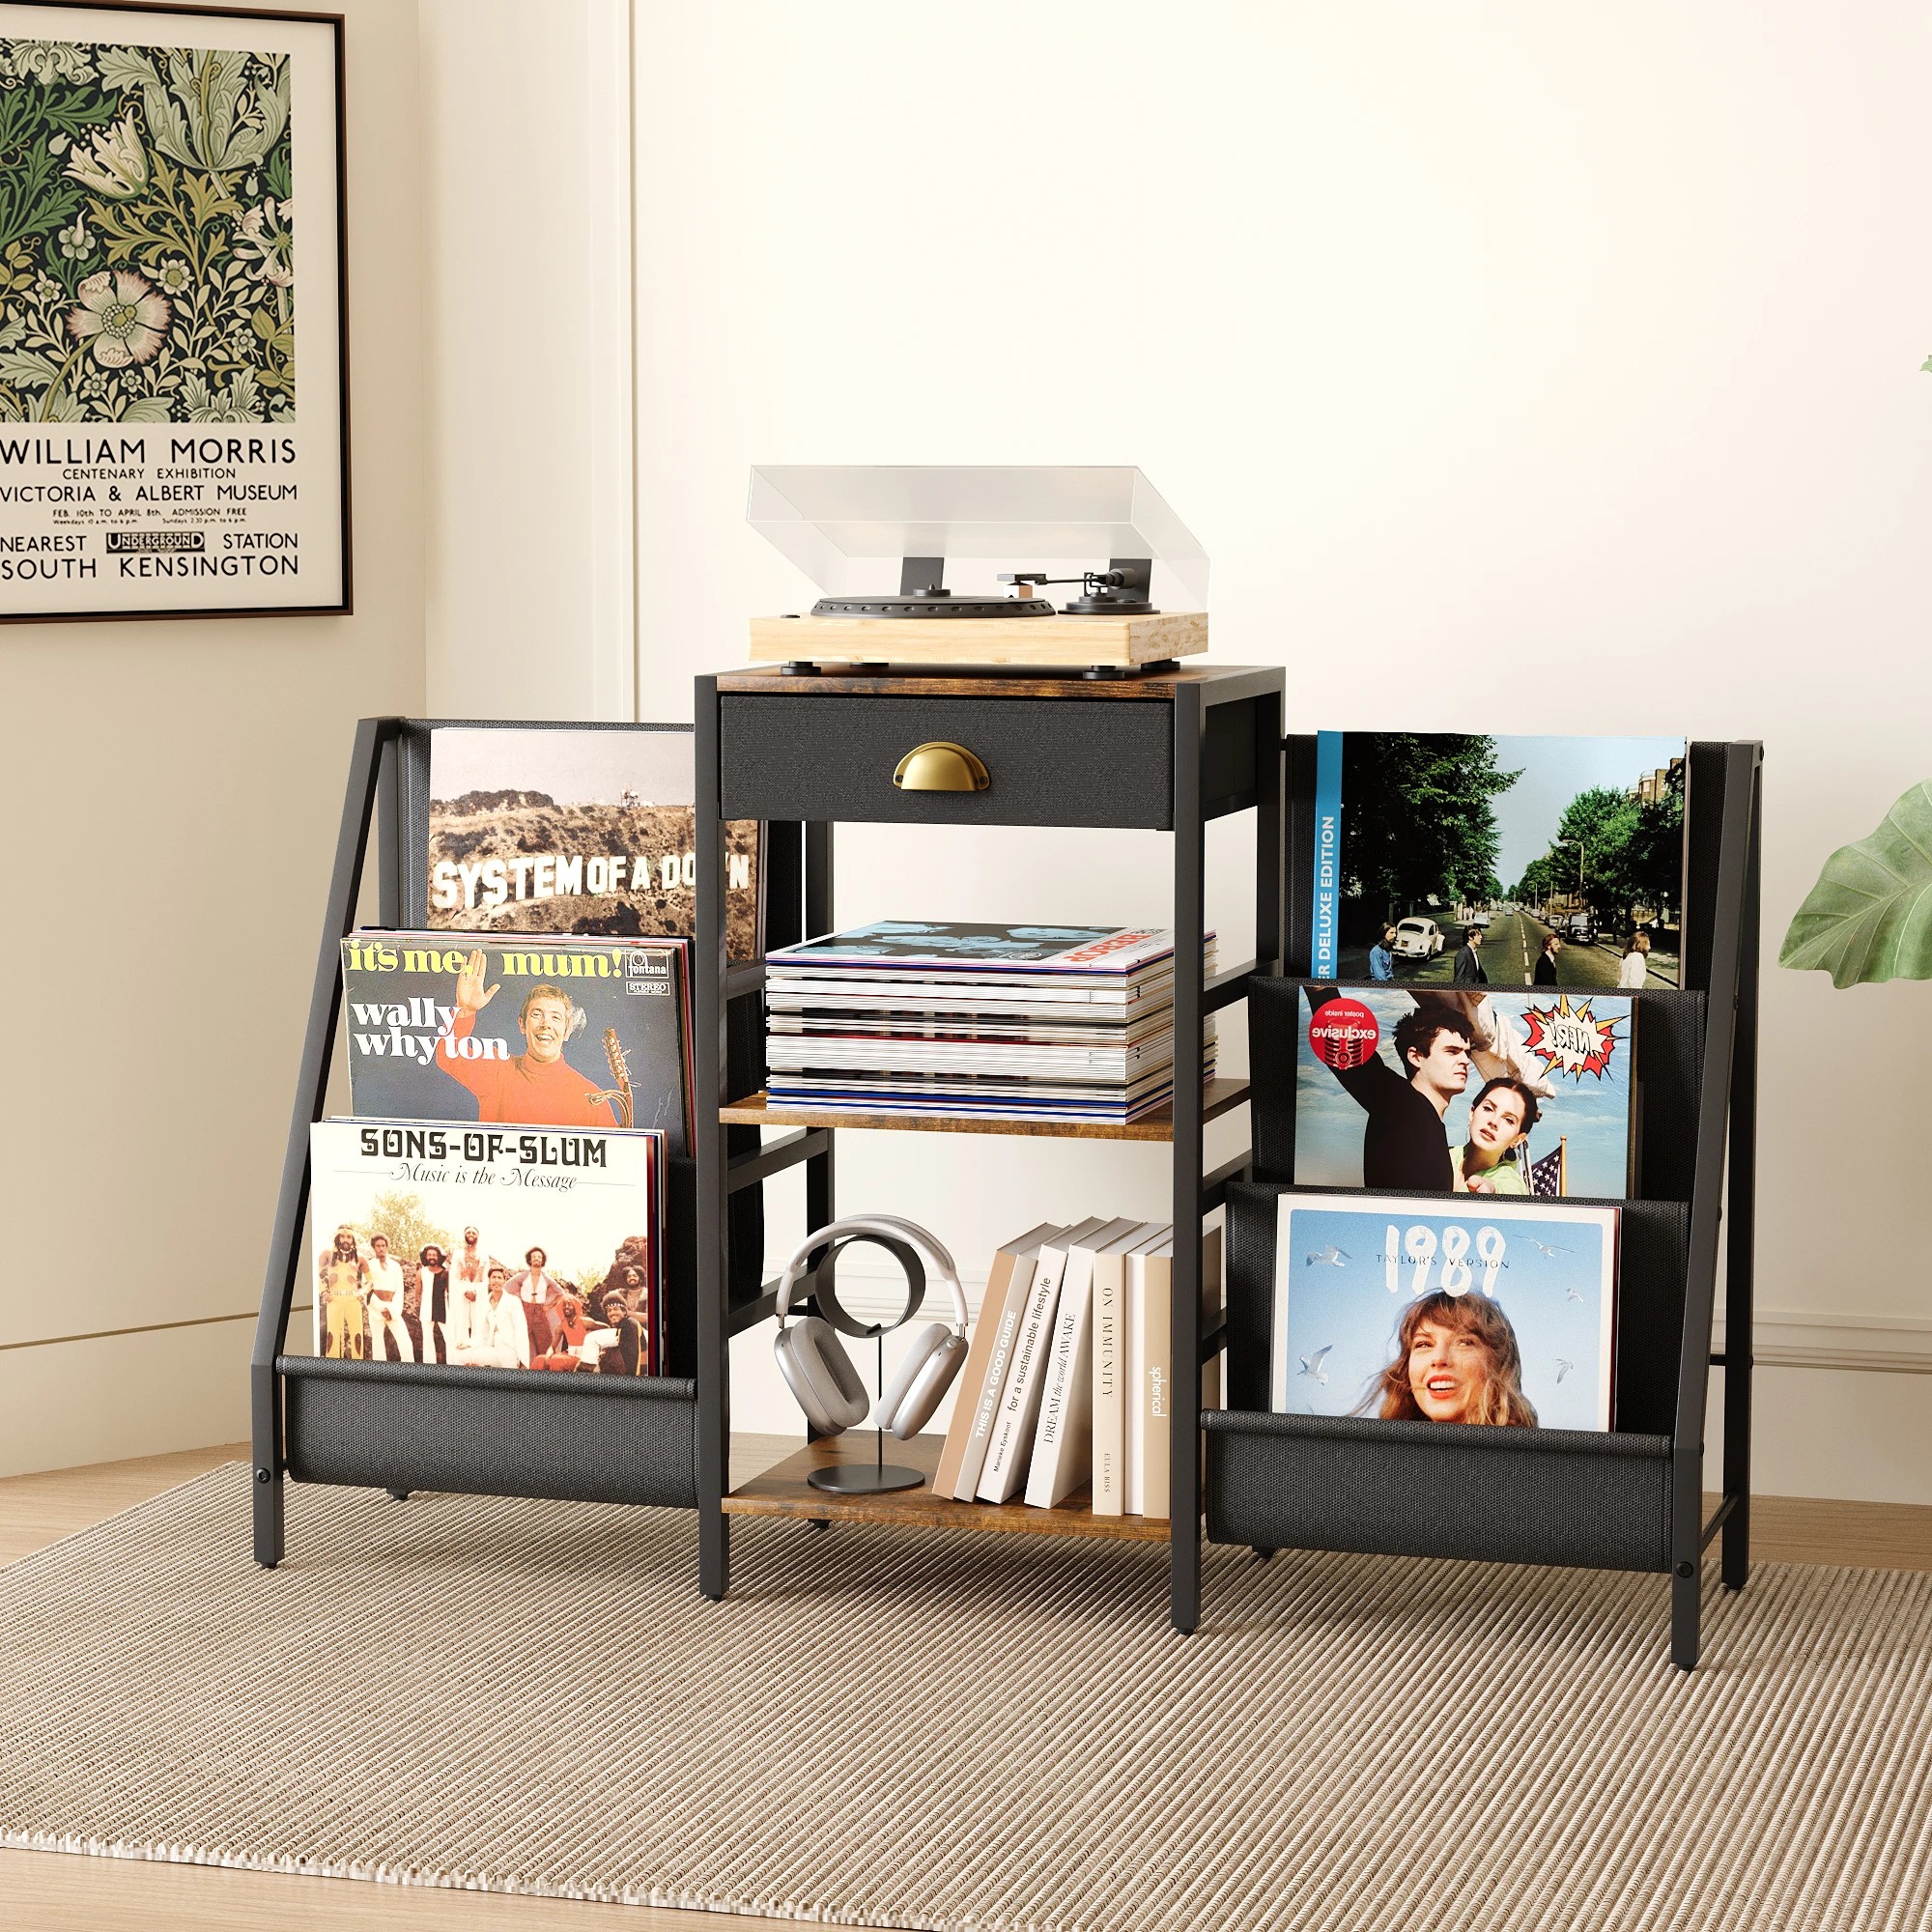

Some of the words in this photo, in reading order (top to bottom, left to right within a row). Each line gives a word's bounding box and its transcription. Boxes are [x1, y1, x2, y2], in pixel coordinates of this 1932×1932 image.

[0, 439, 146, 464] WILLIAM
[171, 439, 296, 464] MORRIS
[63, 469, 145, 479] CENTENARY
[156, 468, 236, 479] EXHIBITION
[0, 486, 96, 502] VICTORIA
[108, 485, 122, 501] &
[135, 485, 205, 501] ALBERT
[217, 484, 298, 500] MUSEUM
[99, 508, 112, 517] TO
[118, 508, 142, 517] APRIL
[172, 507, 220, 516] ADMISSION
[226, 507, 247, 516] FREE
[0, 536, 87, 553] NEAREST
[107, 532, 205, 550] UNDERGROUND
[223, 533, 298, 550] STATION
[2, 558, 96, 580] SOUTH
[120, 554, 298, 578] KENSINGTON
[1320, 816, 1335, 888] EDITION
[432, 855, 582, 909] SYSTEM
[587, 855, 627, 895] OF
[632, 855, 651, 890] A
[662, 851, 750, 890] DON
[1318, 893, 1332, 960] DELUXE
[348, 940, 398, 973] it's
[403, 949, 475, 976] me,
[502, 948, 624, 979] mum!
[629, 982, 667, 991] STEREO
[351, 997, 462, 1037] wally
[355, 1026, 511, 1065] whyton
[388, 1162, 450, 1184] Music
[455, 1165, 468, 1184] is
[473, 1166, 495, 1185] the
[500, 1168, 578, 1193] Message
[1376, 1254, 1437, 1266] TAYLOR'S
[1449, 1257, 1510, 1268] VERSION
[1384, 1224, 1507, 1298] 1989
[1102, 1288, 1113, 1307] ON
[1000, 1310, 1016, 1348] GUIDE
[1008, 1396, 1019, 1411] for
[1017, 1322, 1039, 1384] sustainable
[1032, 1277, 1051, 1320] lifestyle
[990, 1350, 1006, 1385] GOOD
[1102, 1317, 1113, 1397] IMMUNITY
[987, 1388, 997, 1397] A
[1044, 1398, 1061, 1443] DREAM
[1053, 1383, 1063, 1397] the
[1060, 1313, 1075, 1357] AWAKE
[1149, 1366, 1167, 1417] spherical
[983, 1398, 993, 1410] IS
[976, 1412, 989, 1437] THIS
